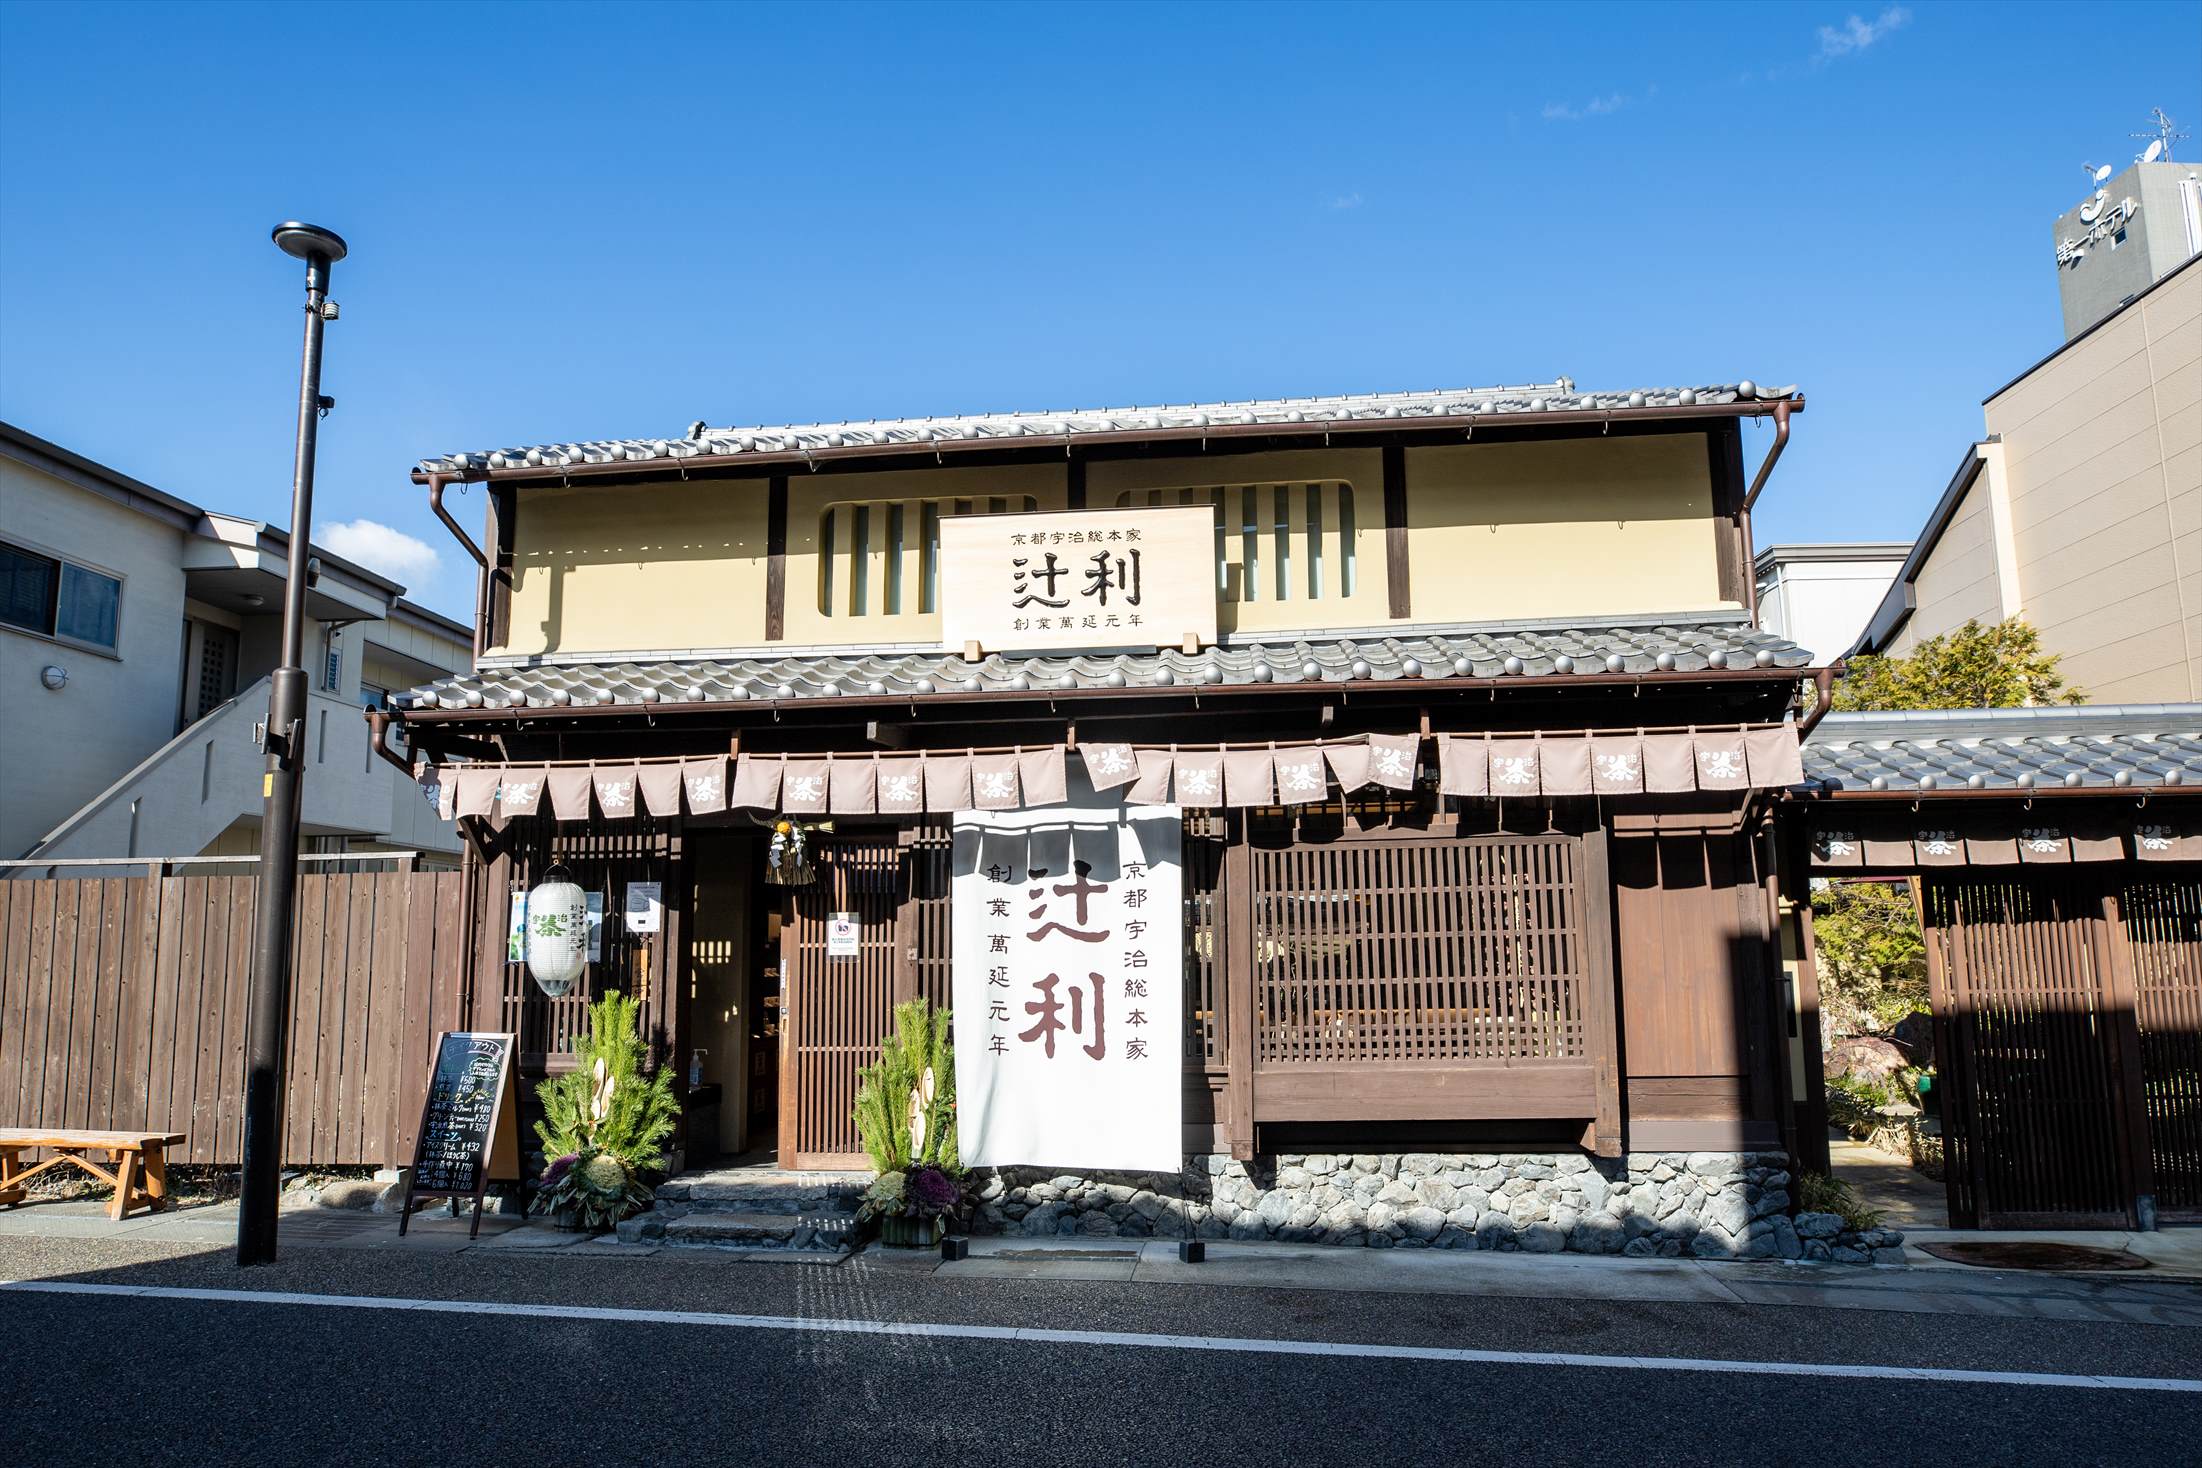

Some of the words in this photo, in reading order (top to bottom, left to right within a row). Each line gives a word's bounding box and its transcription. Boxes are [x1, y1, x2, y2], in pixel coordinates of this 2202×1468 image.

[1010, 527, 1142, 546] 京都宇治総本家
[1012, 548, 1142, 608] 辻利
[1013, 612, 1144, 631] 創業萬延元年
[986, 864, 1012, 1056] 創業萬延元年
[1018, 859, 1110, 1061] 辻利
[1123, 860, 1148, 1060] 京都宇治総本家
